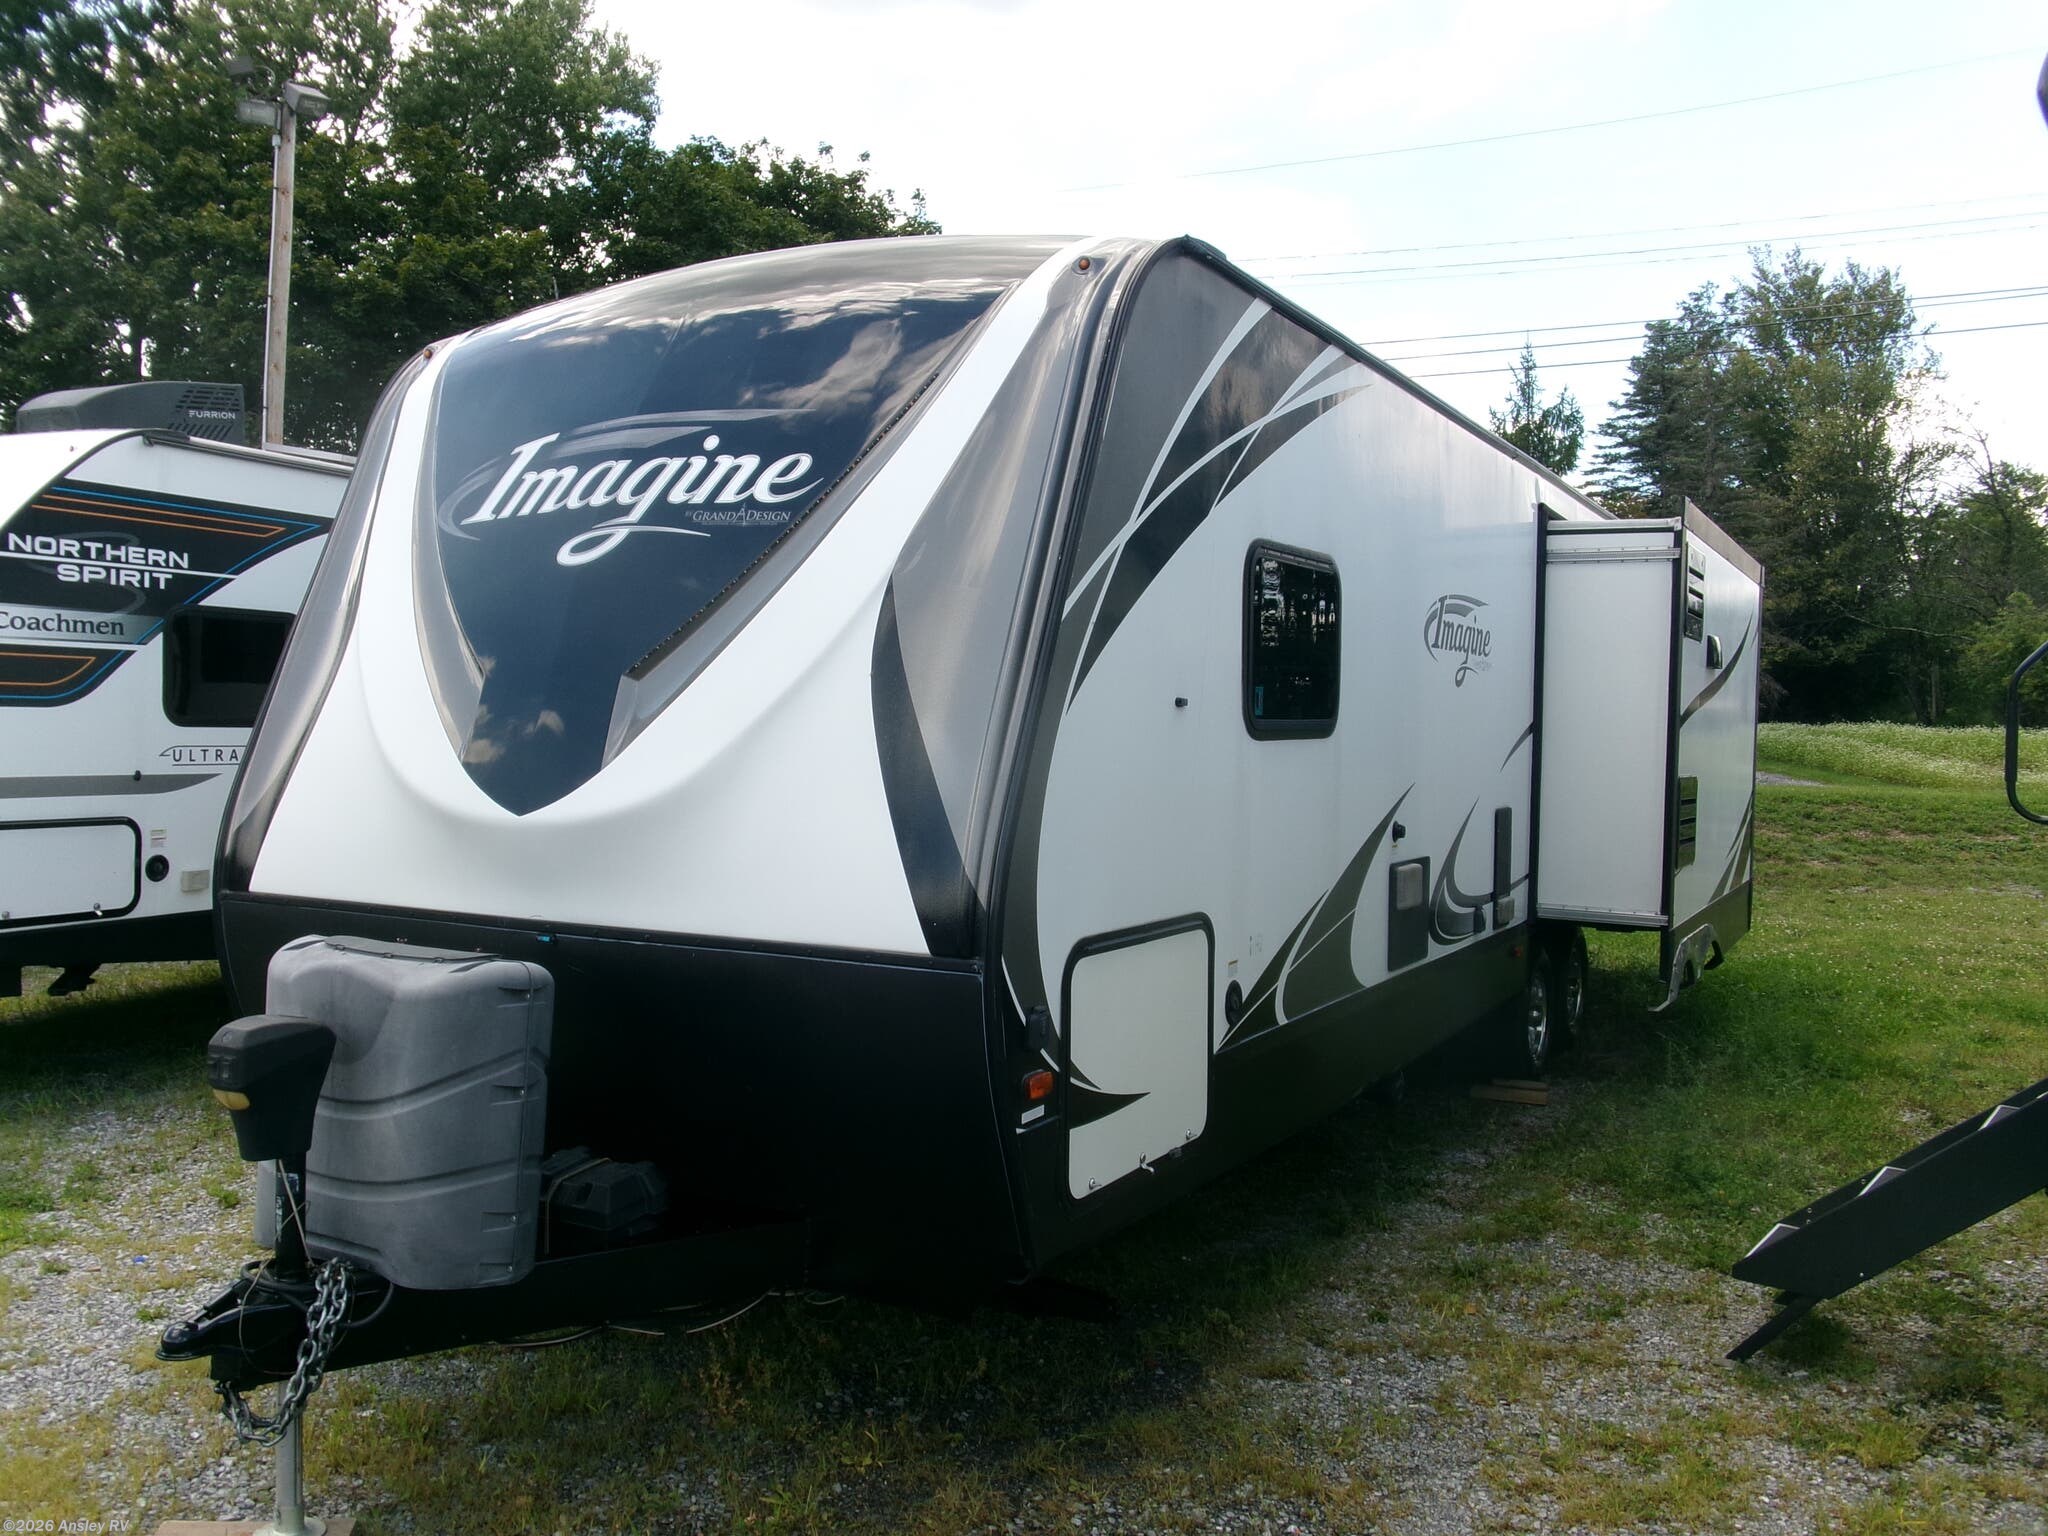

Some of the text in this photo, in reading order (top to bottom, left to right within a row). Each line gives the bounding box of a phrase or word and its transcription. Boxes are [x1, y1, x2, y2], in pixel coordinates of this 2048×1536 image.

[188, 410, 236, 420] FURRION
[460, 432, 824, 567] Imagine
[692, 510, 736, 521] GRAND
[746, 509, 792, 521] DESIGN
[8, 532, 189, 569] NORTHERN
[56, 563, 173, 590] SPIRIT
[0, 611, 125, 635] Coachmen
[1431, 594, 1493, 688] Imagine
[172, 748, 239, 762] ULTRA
